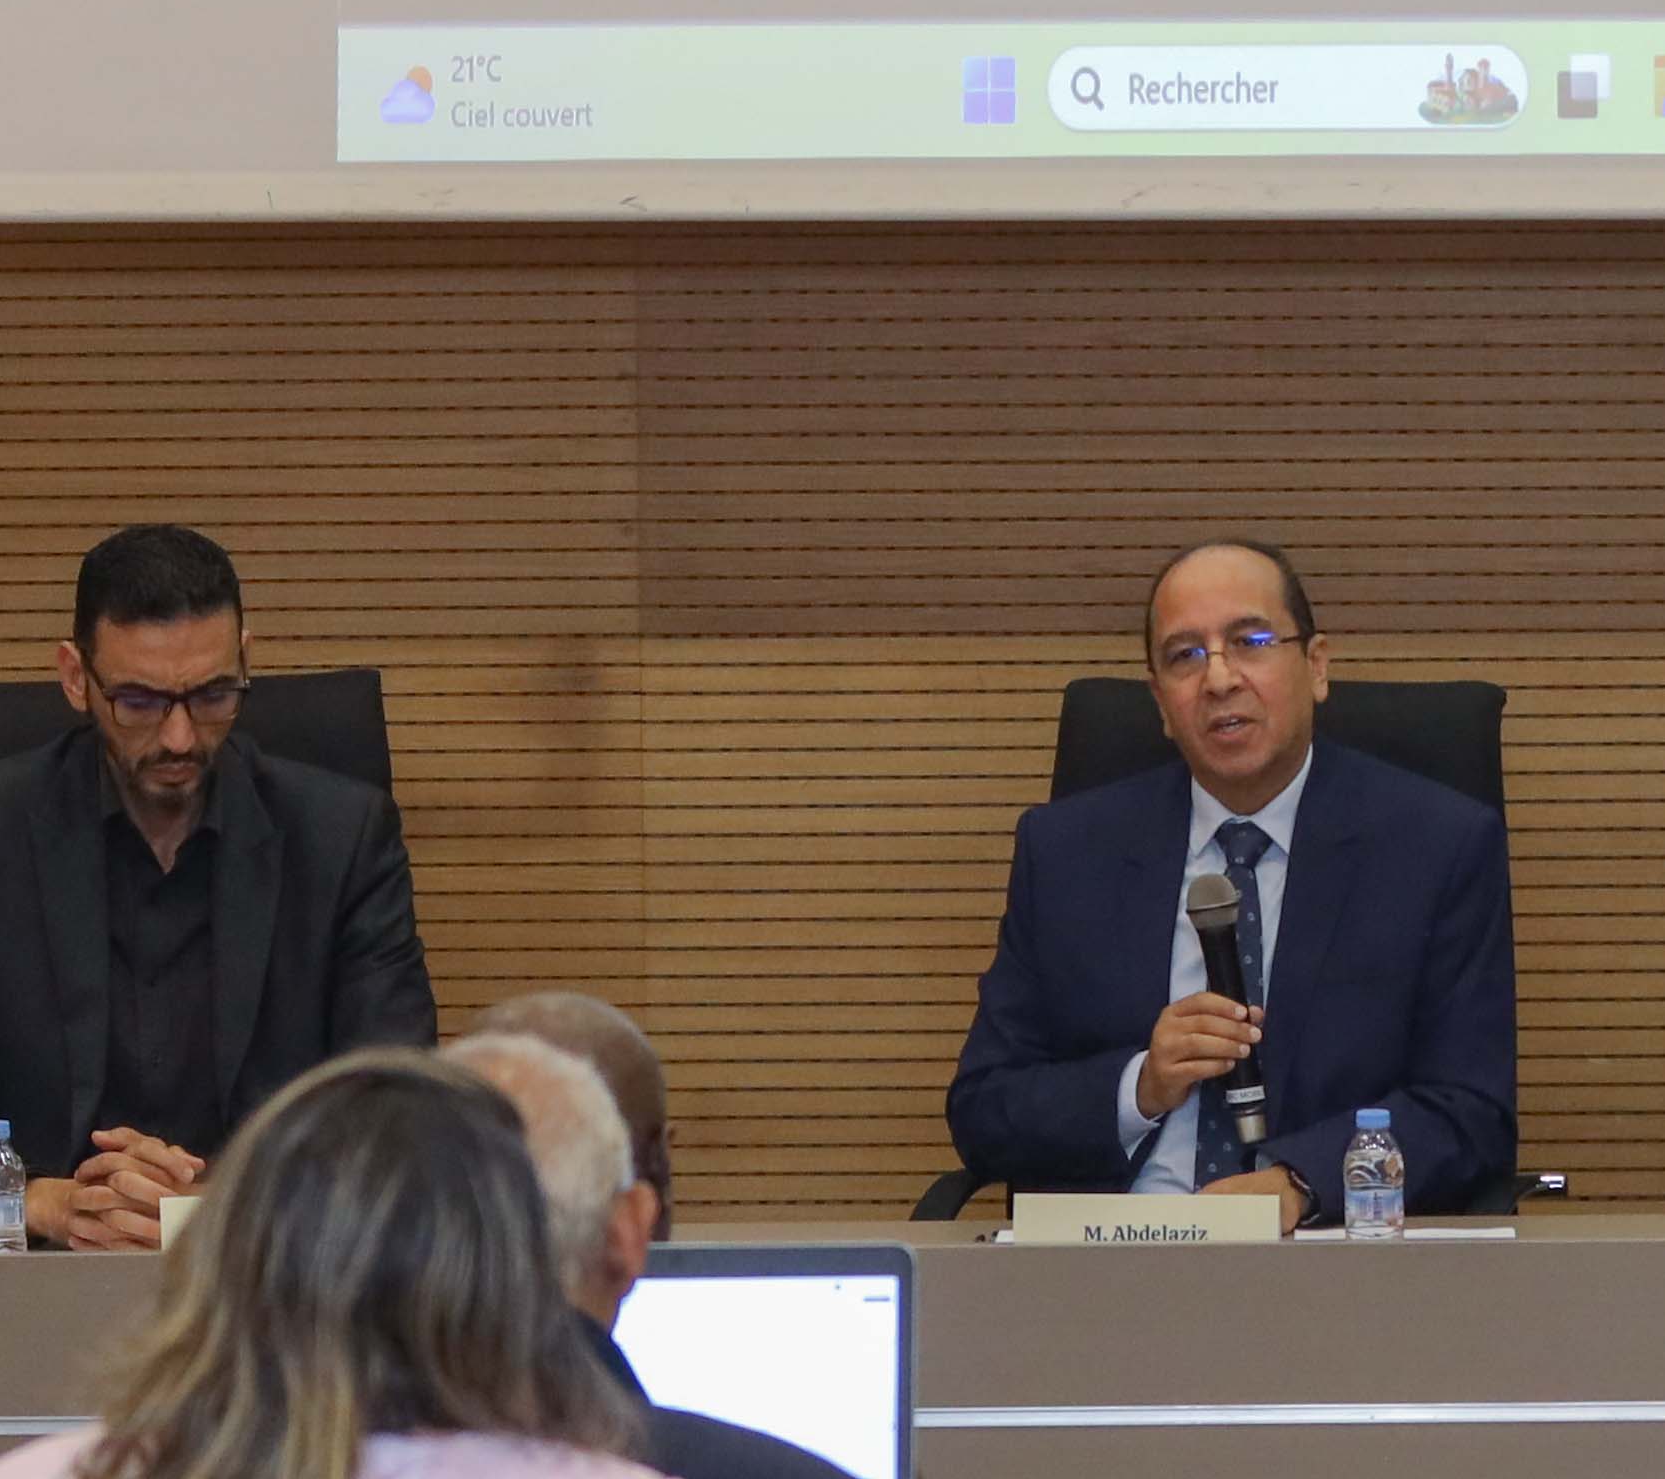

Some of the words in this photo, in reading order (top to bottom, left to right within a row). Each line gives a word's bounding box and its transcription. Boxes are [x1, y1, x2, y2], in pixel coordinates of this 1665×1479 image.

[452, 56, 501, 82] 21°C
[1129, 72, 1278, 105] Rechercher
[451, 101, 494, 128] Ciel
[503, 104, 592, 127] couvert
[1084, 1225, 1107, 1242] M.
[1113, 1224, 1208, 1241] Abdelaziz
